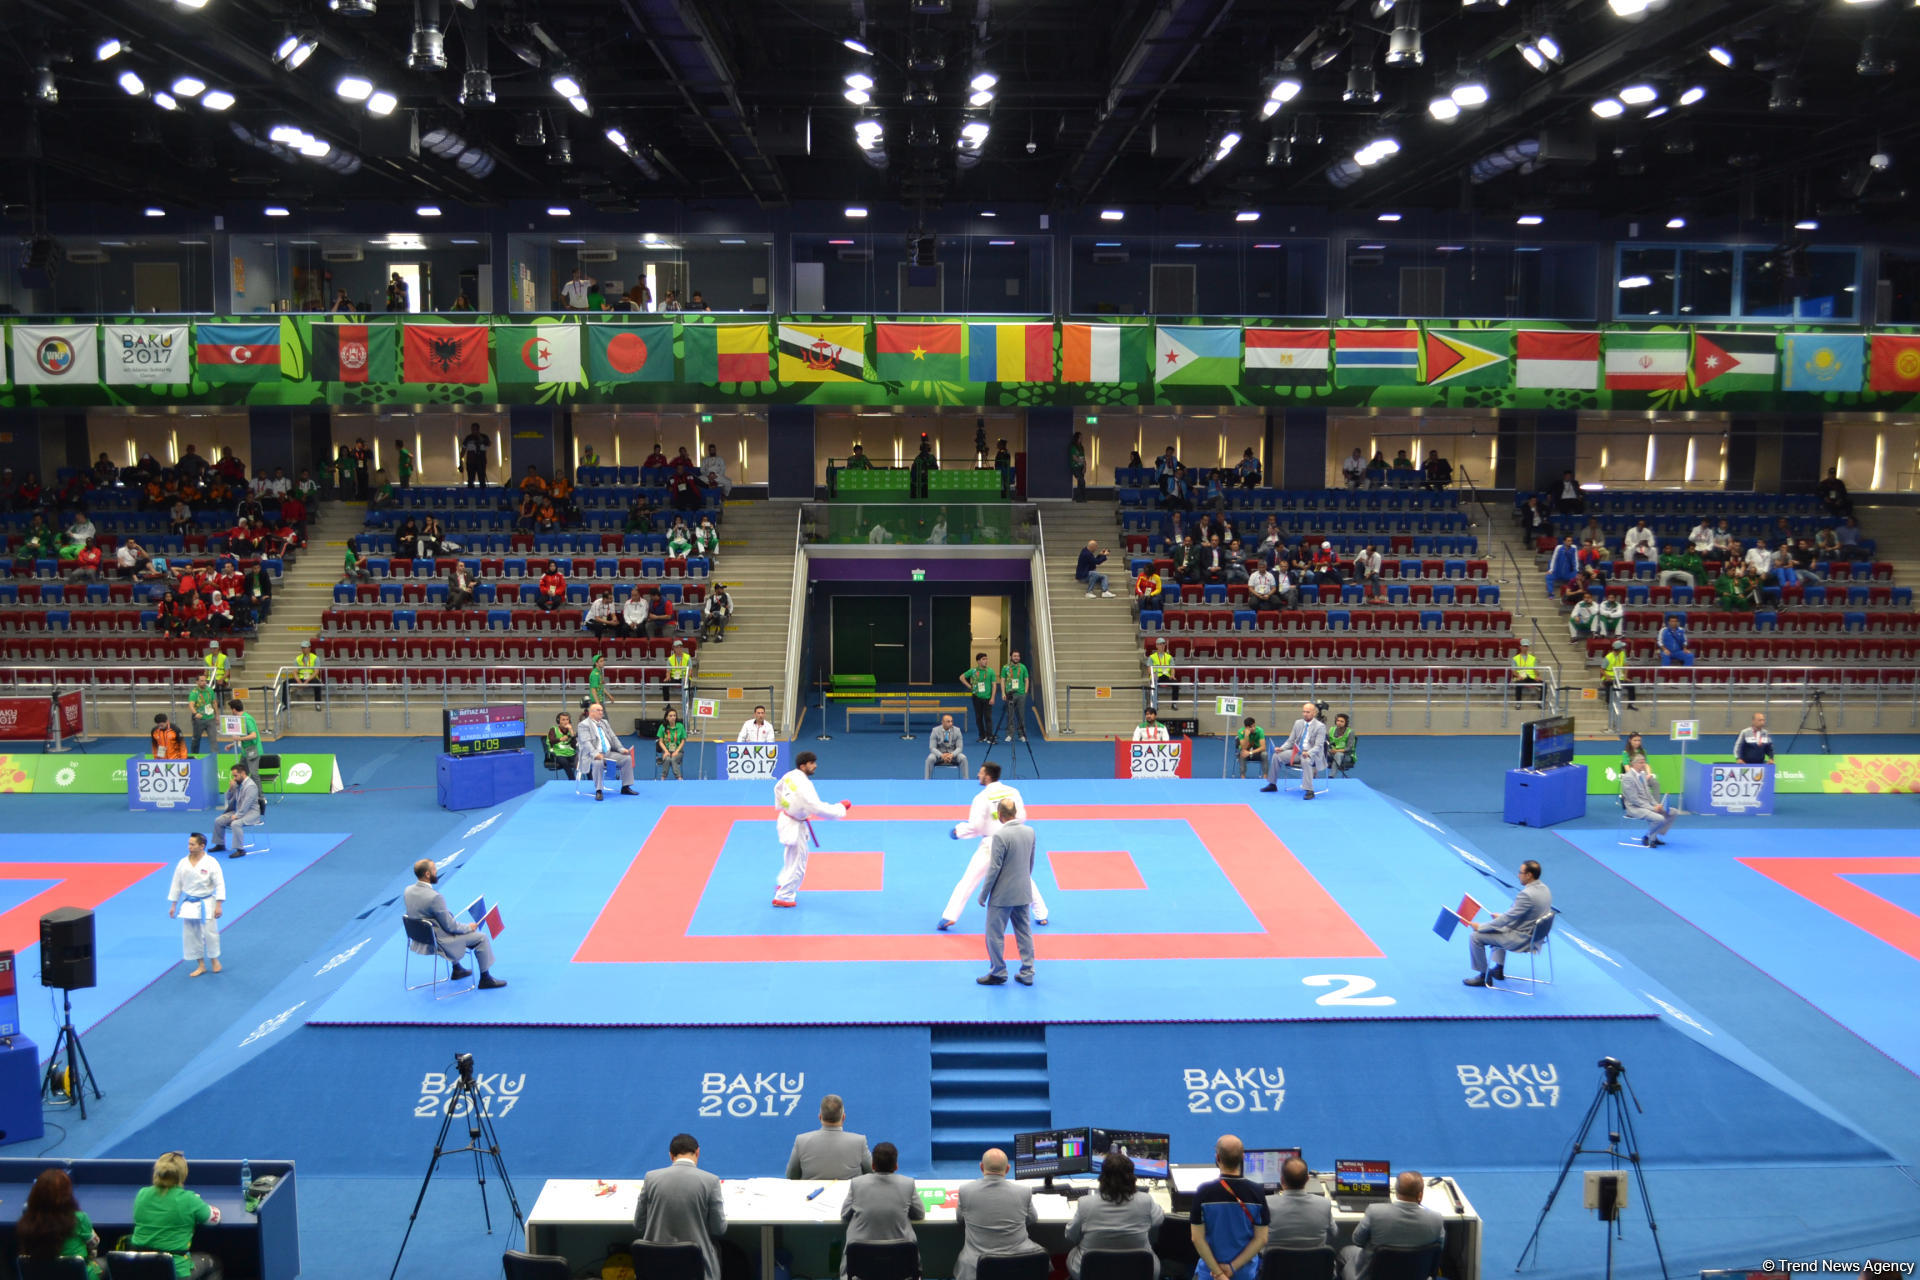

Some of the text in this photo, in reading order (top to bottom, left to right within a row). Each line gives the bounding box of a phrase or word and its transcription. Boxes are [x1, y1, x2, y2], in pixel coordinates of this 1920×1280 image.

[122, 334, 173, 348] BAKU
[123, 349, 172, 364] 2017
[0, 716, 18, 725] 017
[728, 746, 777, 759] BAKU
[1132, 744, 1180, 758] BAKU
[138, 763, 190, 778] BAKU
[728, 760, 776, 774] 2017
[1132, 758, 1179, 772] 2017
[1713, 768, 1763, 782] BAKU
[139, 778, 189, 793] 2017
[1712, 783, 1761, 798] 2017
[1301, 974, 1397, 1006] 2
[1183, 1066, 1286, 1090] BAKU
[1456, 1063, 1558, 1086] BAKU
[701, 1072, 805, 1094] BAKU
[1187, 1089, 1286, 1113] 2017
[1464, 1085, 1560, 1108] 2017
[414, 1095, 520, 1118] 2017
[698, 1094, 802, 1117] 2017
